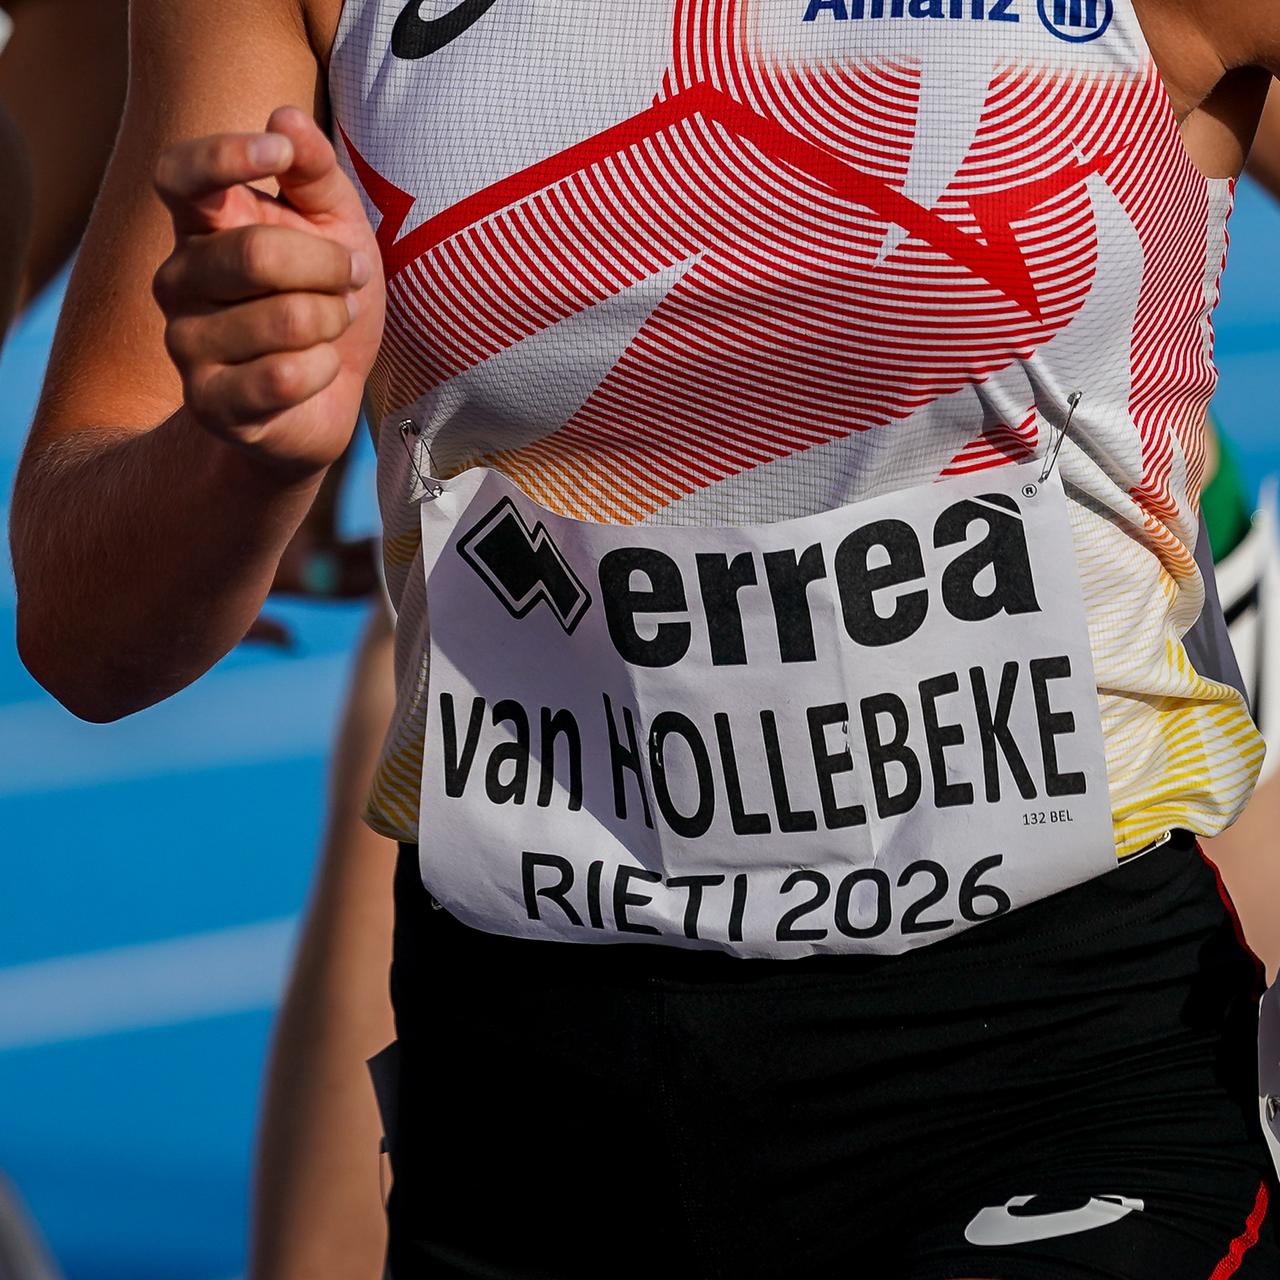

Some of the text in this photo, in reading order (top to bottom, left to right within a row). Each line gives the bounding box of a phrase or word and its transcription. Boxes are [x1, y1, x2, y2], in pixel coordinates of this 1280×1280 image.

[439, 692, 583, 813] van
[603, 656, 1086, 838] HOLLEBEKE
[1023, 809, 1073, 826] 132 BEL
[521, 851, 1011, 942] RIETI 2026
